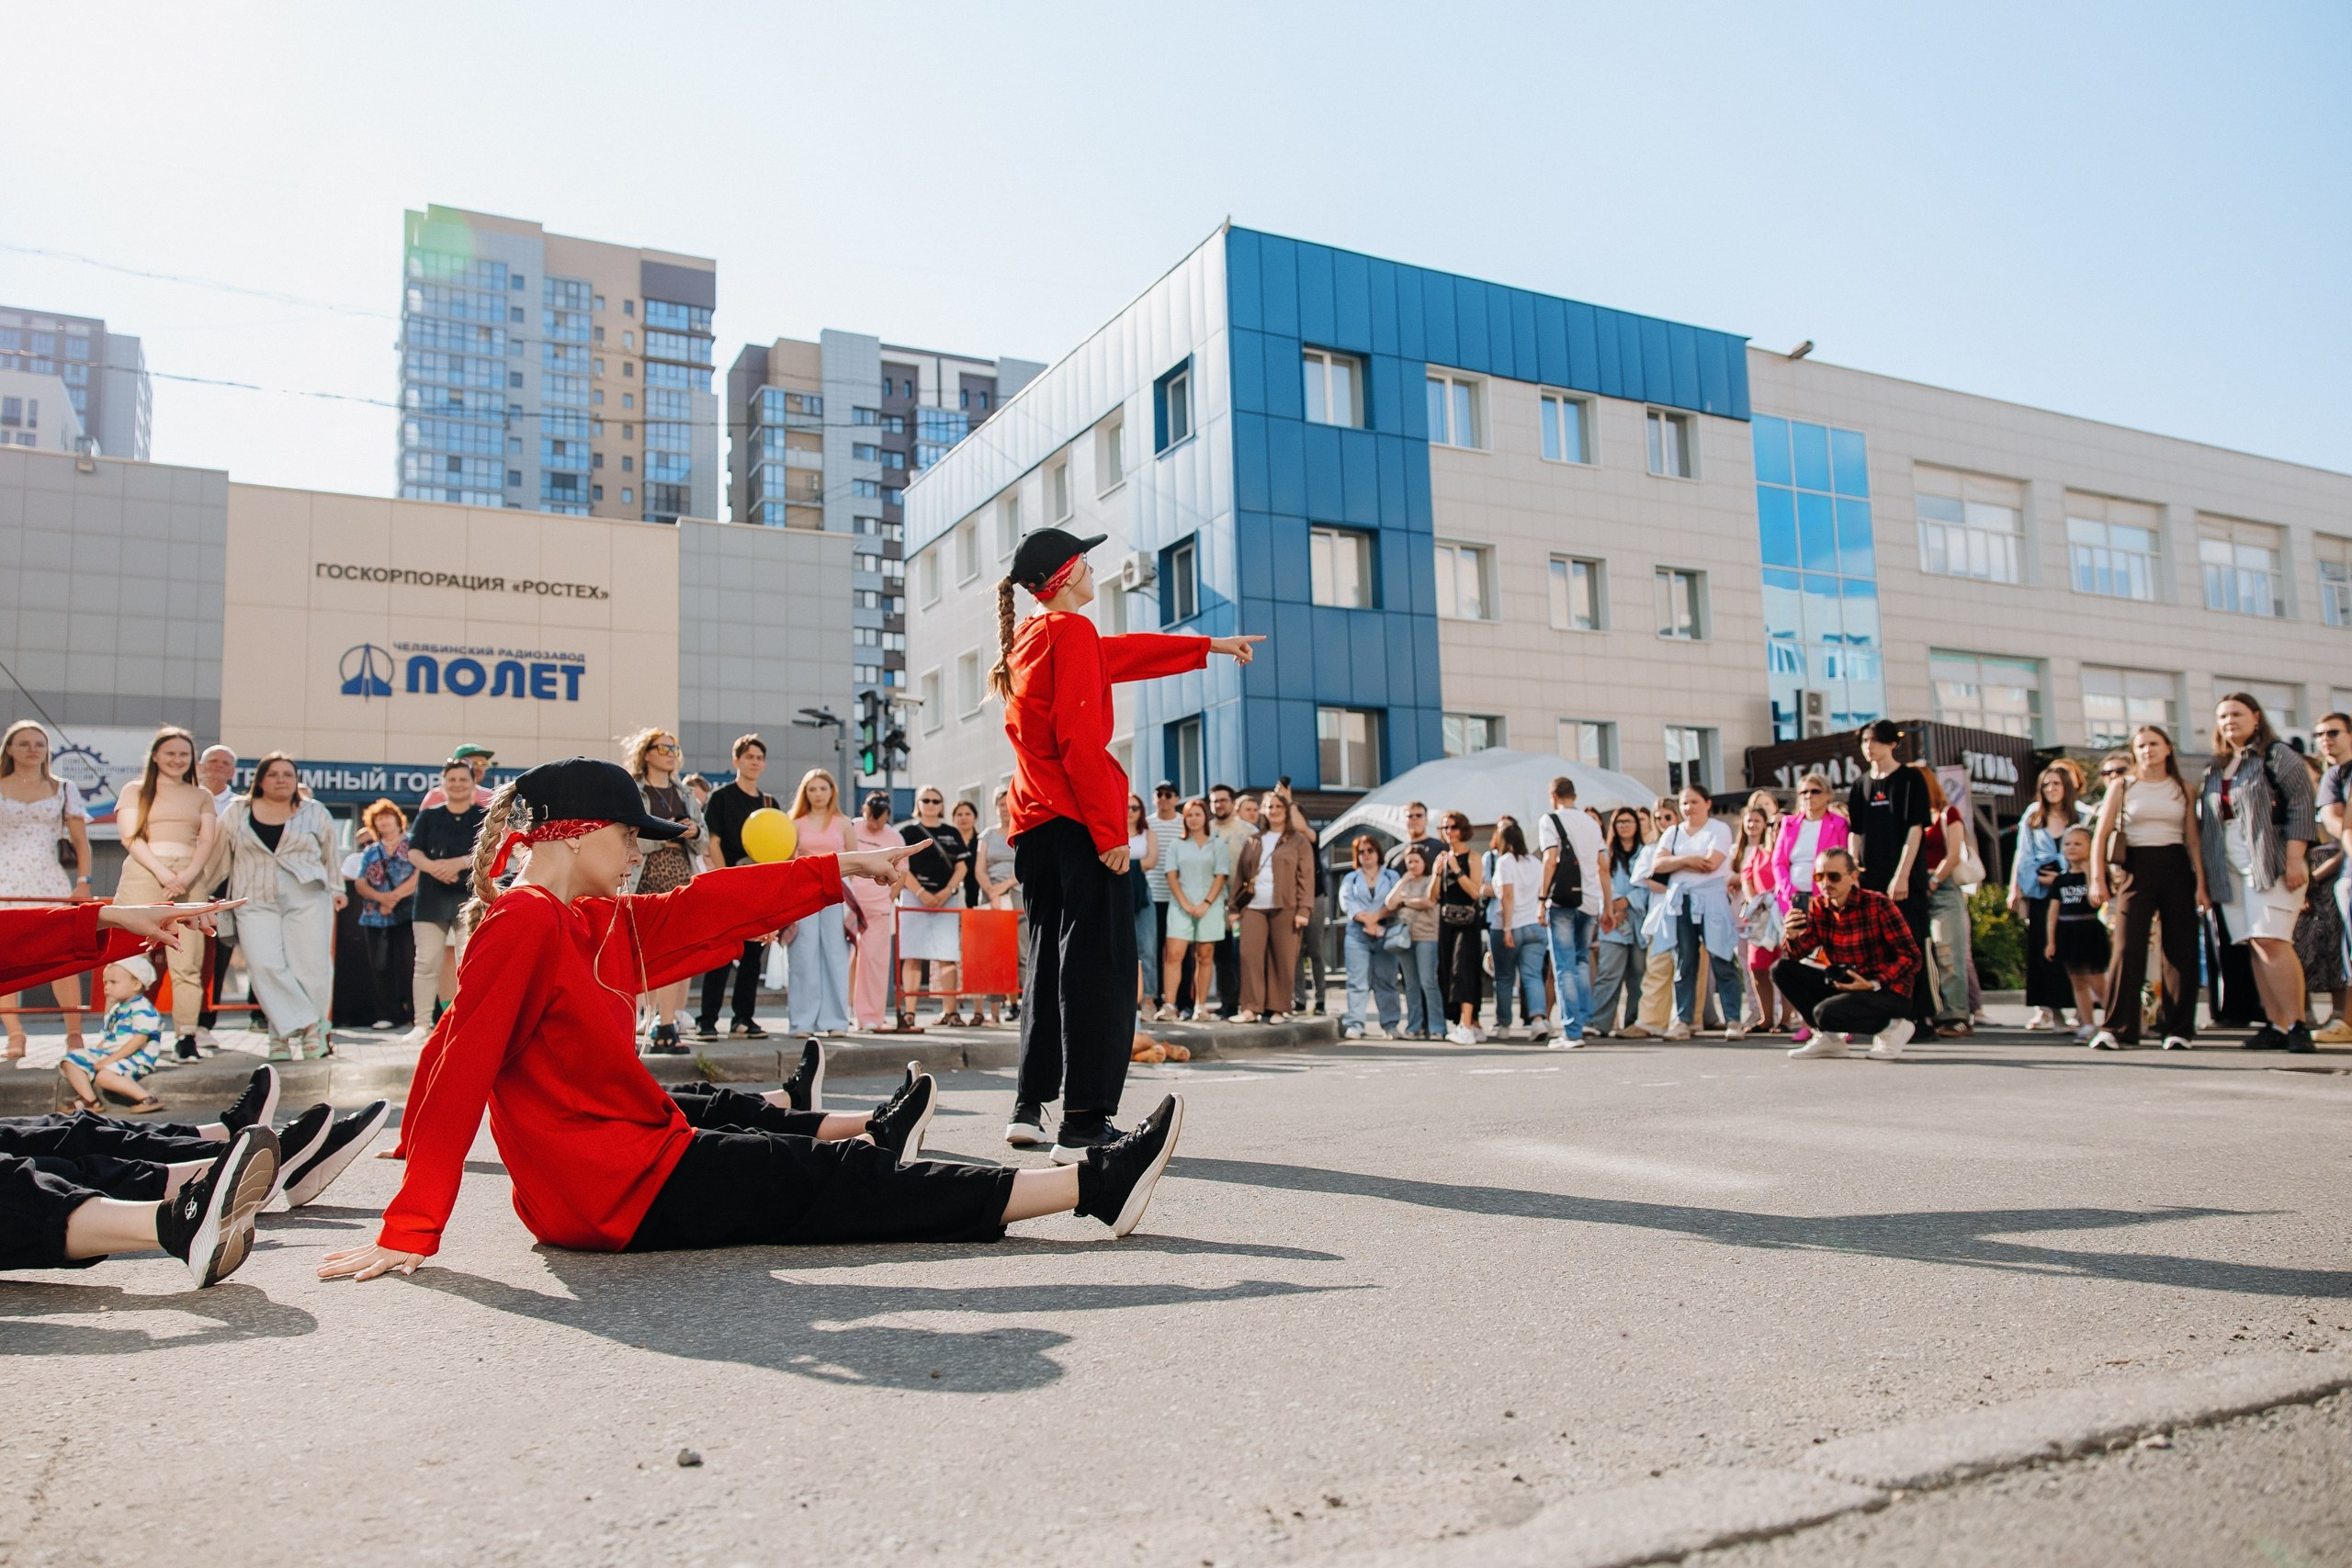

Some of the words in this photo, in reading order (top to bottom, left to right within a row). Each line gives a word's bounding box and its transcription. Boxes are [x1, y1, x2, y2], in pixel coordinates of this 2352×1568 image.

[315, 562, 505, 592] ГОСКОРПОРАЦИЯ
[512, 579, 610, 600] «РОСТЕХ»
[393, 641, 494, 657] ЧЕЛЯБИНСКИЙ
[498, 648, 585, 663] РАДИОЗАВОД
[405, 655, 586, 702] ПОЛЕТ
[297, 766, 384, 792] МНЫЙ
[393, 772, 444, 794] ГОР
